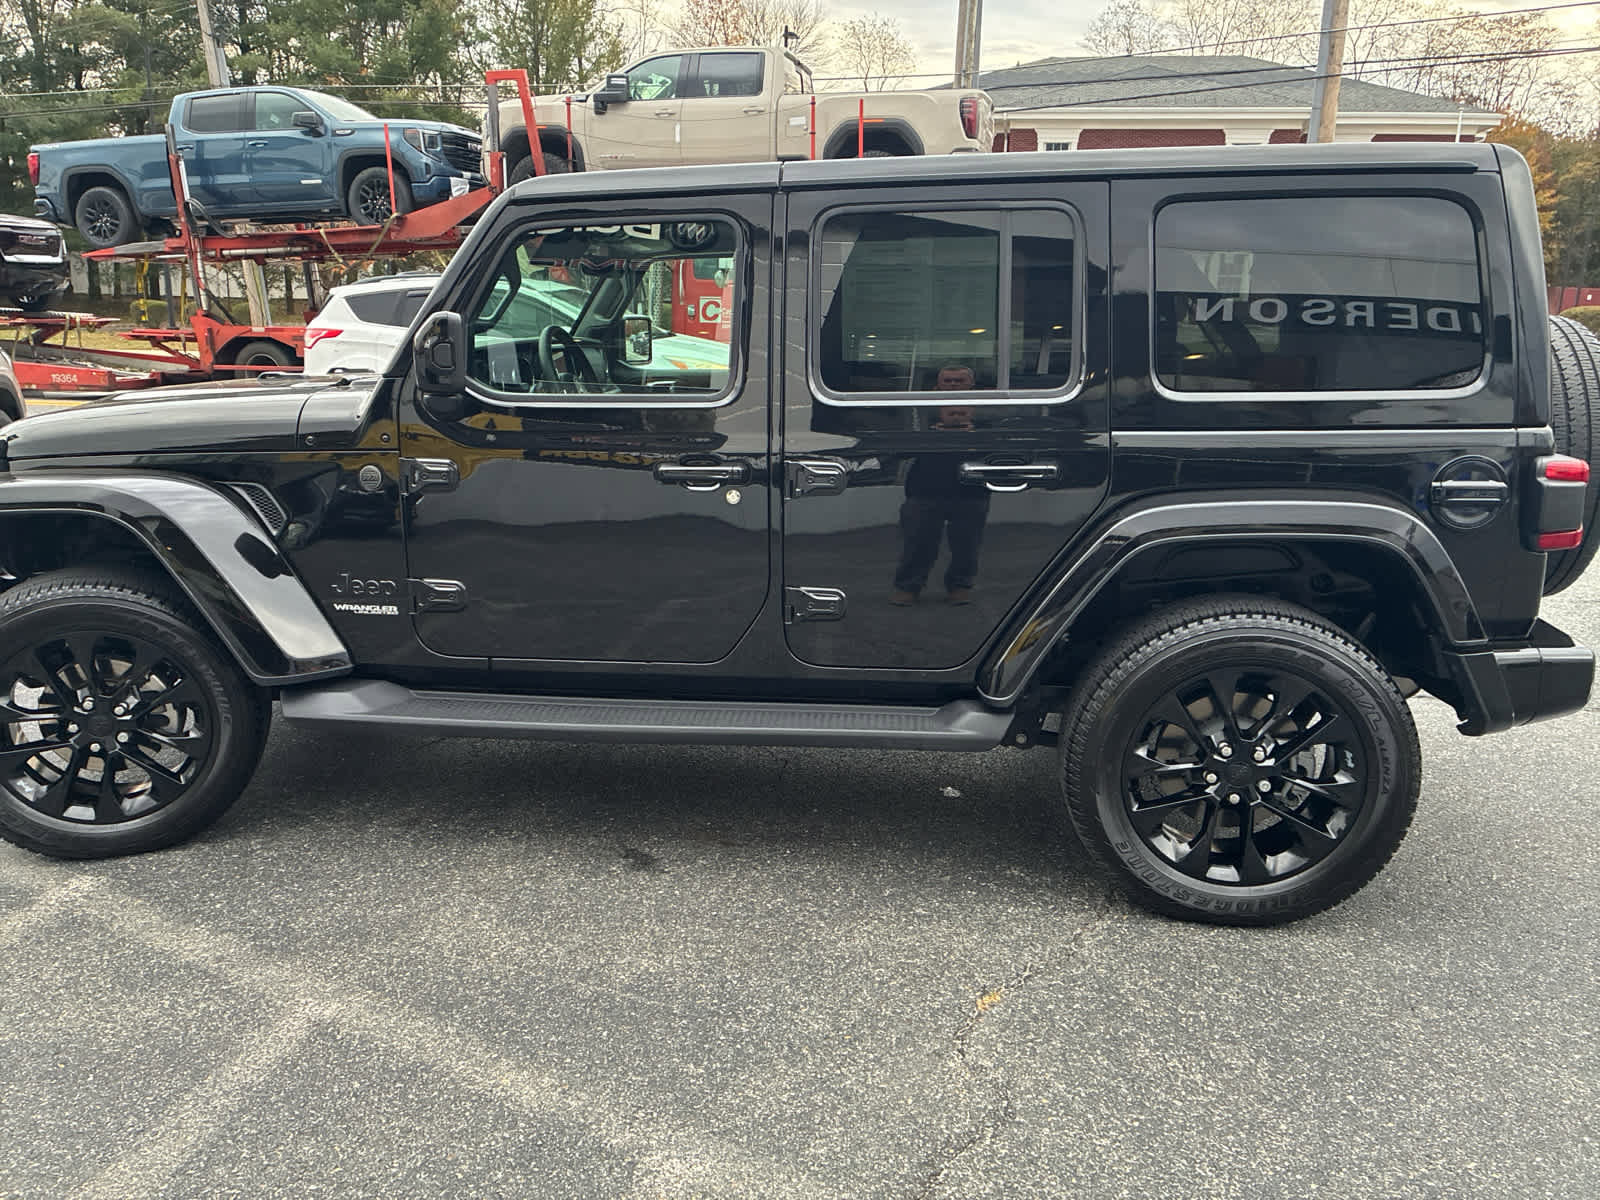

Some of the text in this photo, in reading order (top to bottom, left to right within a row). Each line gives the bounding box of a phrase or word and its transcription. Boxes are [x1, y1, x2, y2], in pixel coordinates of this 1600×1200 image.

[701, 300, 721, 321] C
[329, 571, 398, 600] Jeep
[333, 603, 398, 611] WRANGLER
